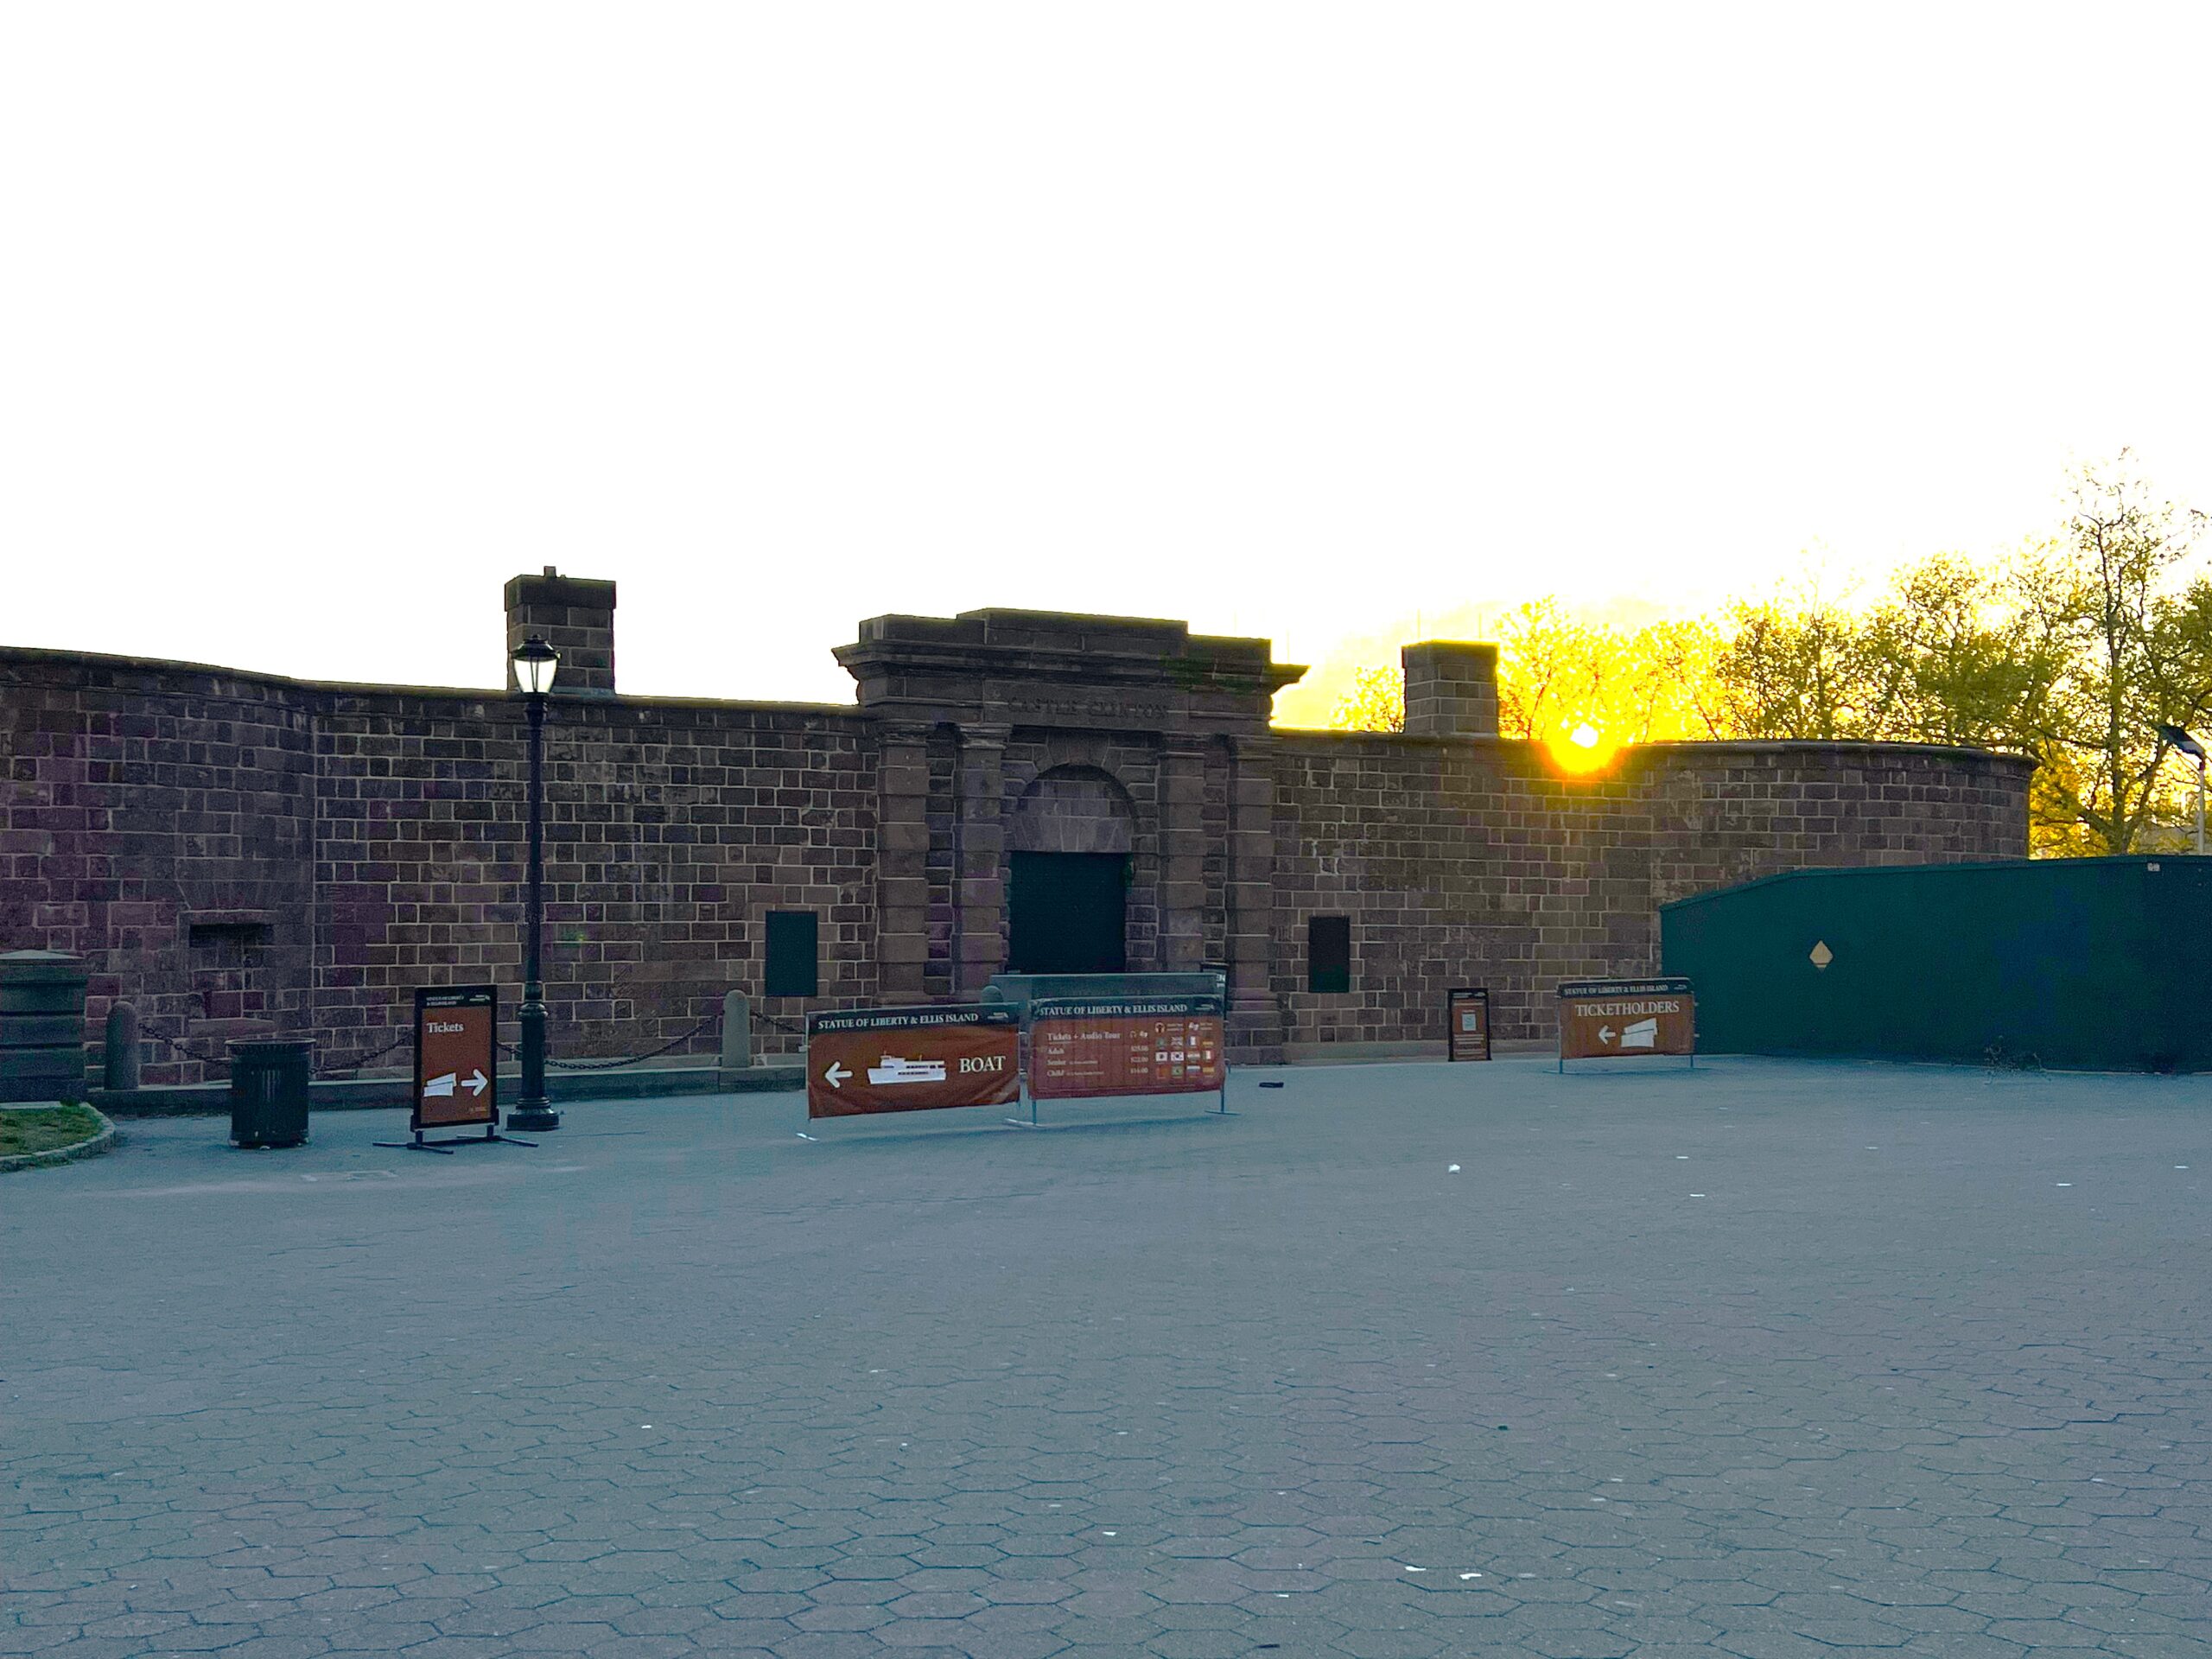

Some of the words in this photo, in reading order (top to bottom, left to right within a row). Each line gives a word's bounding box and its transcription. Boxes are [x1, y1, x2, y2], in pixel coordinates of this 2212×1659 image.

[1039, 1006, 1072, 1015] STATUE
[1073, 1006, 1085, 1015] OF
[1087, 1005, 1123, 1014] LIBERTY
[1124, 1005, 1132, 1014] &
[1133, 1004, 1157, 1014] ELLIS
[1158, 1004, 1187, 1013] ISLAND
[1574, 1001, 1680, 1017] TICKETHOLDERS
[426, 1021, 465, 1033] Tickets
[818, 1019, 855, 1030] STATUE
[855, 1018, 869, 1028] OF
[870, 1016, 909, 1027] LIBERTY
[910, 1016, 918, 1025] &
[919, 1014, 944, 1025] ELLIS
[945, 1013, 978, 1023] ISLAND
[1047, 1032, 1071, 1041] Tickets
[1080, 1032, 1103, 1040] Audio
[1104, 1031, 1121, 1039] Tour
[959, 1055, 1007, 1073] BOAT
